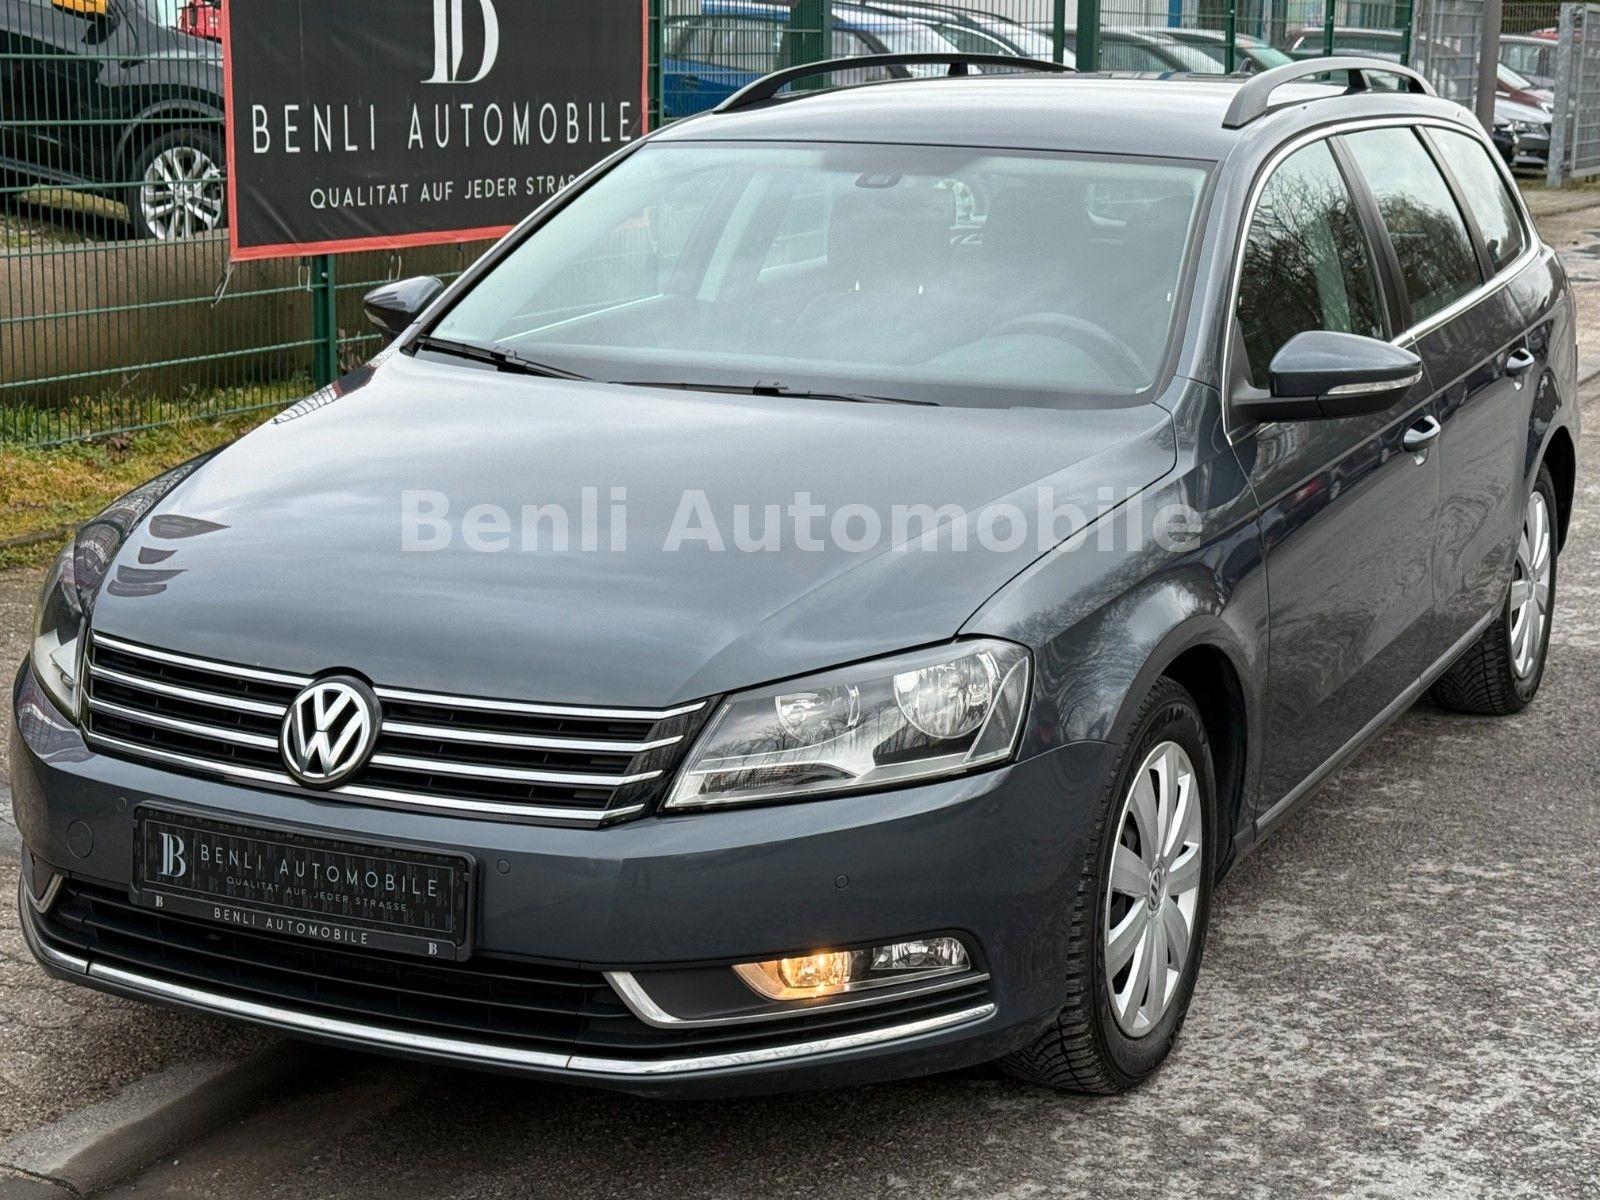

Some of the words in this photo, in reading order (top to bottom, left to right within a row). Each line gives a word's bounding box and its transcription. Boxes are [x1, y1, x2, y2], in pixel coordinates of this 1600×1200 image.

[252, 103, 375, 154] BENLI
[408, 100, 631, 150] AUTOMOBILE
[310, 183, 409, 209] QUALITÄT
[420, 181, 454, 202] AUF
[464, 177, 517, 200] JEDER
[283, 682, 371, 778] VW
[157, 832, 187, 878] B
[201, 844, 262, 871] BENLI
[279, 858, 438, 898] AUTOMOBILE
[314, 890, 349, 903] JEDER
[355, 896, 407, 912] STRASSE
[214, 907, 256, 926] BENLI
[265, 917, 368, 945] AUTOMOBILE
